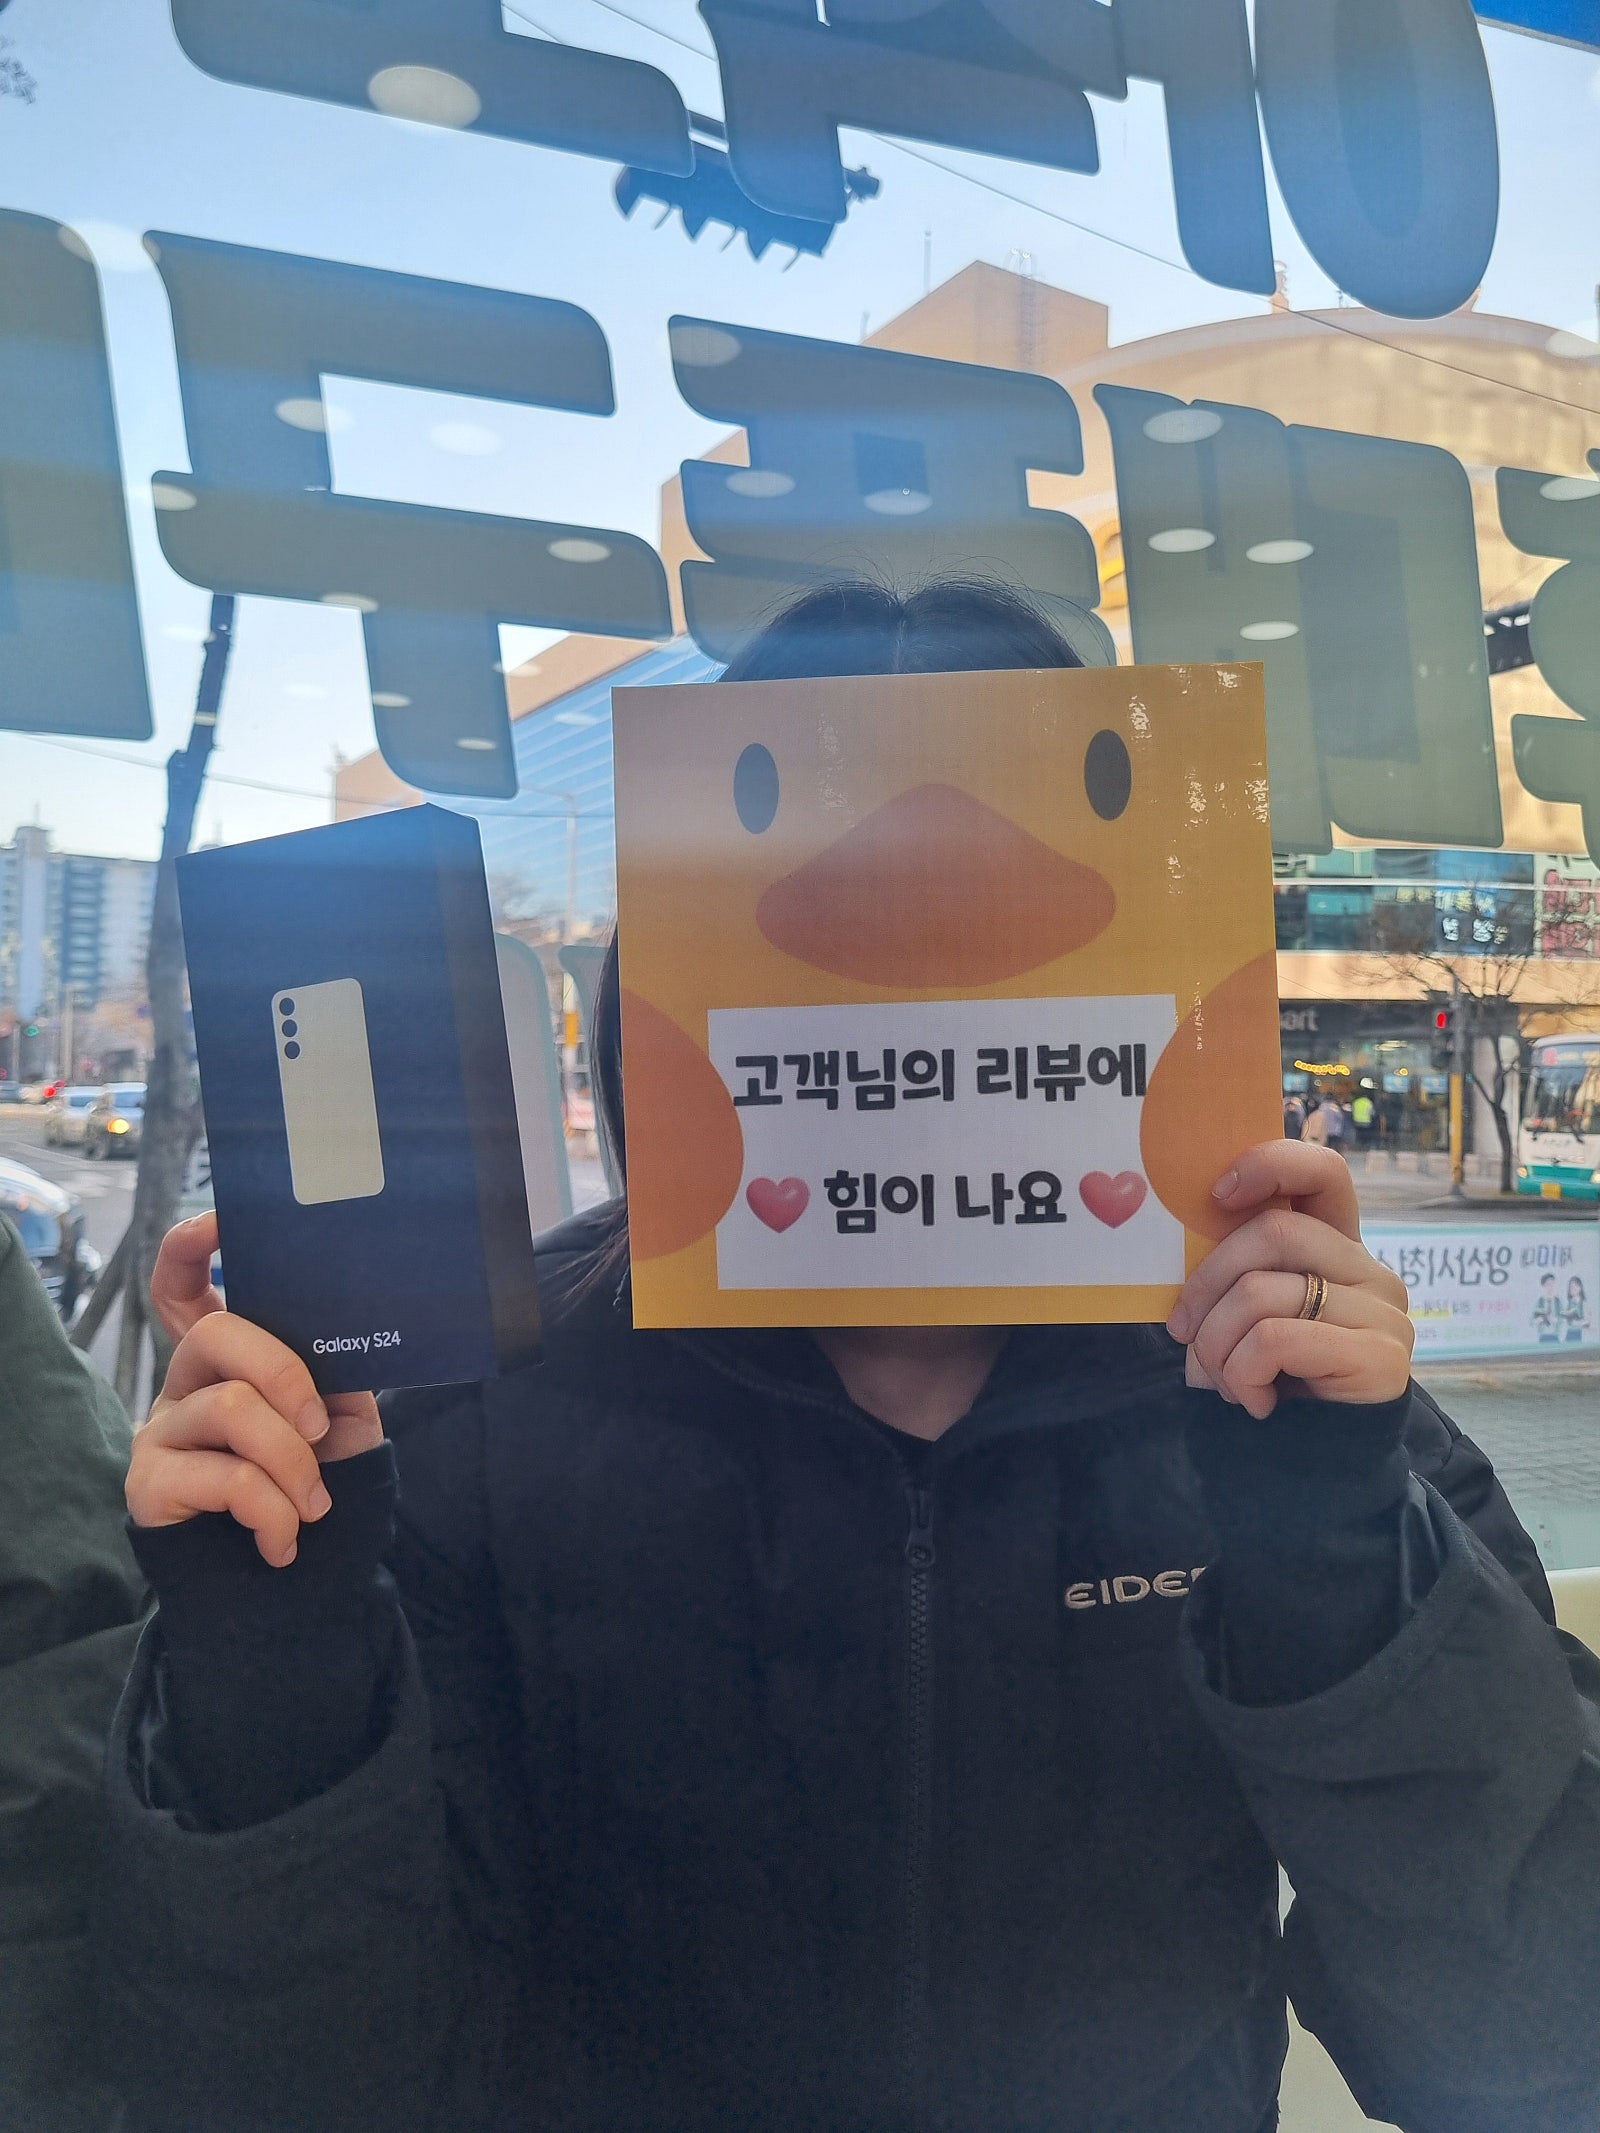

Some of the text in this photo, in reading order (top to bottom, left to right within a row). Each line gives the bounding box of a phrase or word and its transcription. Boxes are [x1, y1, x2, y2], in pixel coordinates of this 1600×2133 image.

[732, 1043, 1147, 1111] 고객님의 리뷰에
[823, 1170, 1067, 1235] 힘이 나요
[312, 1330, 402, 1354] Galaxy S24
